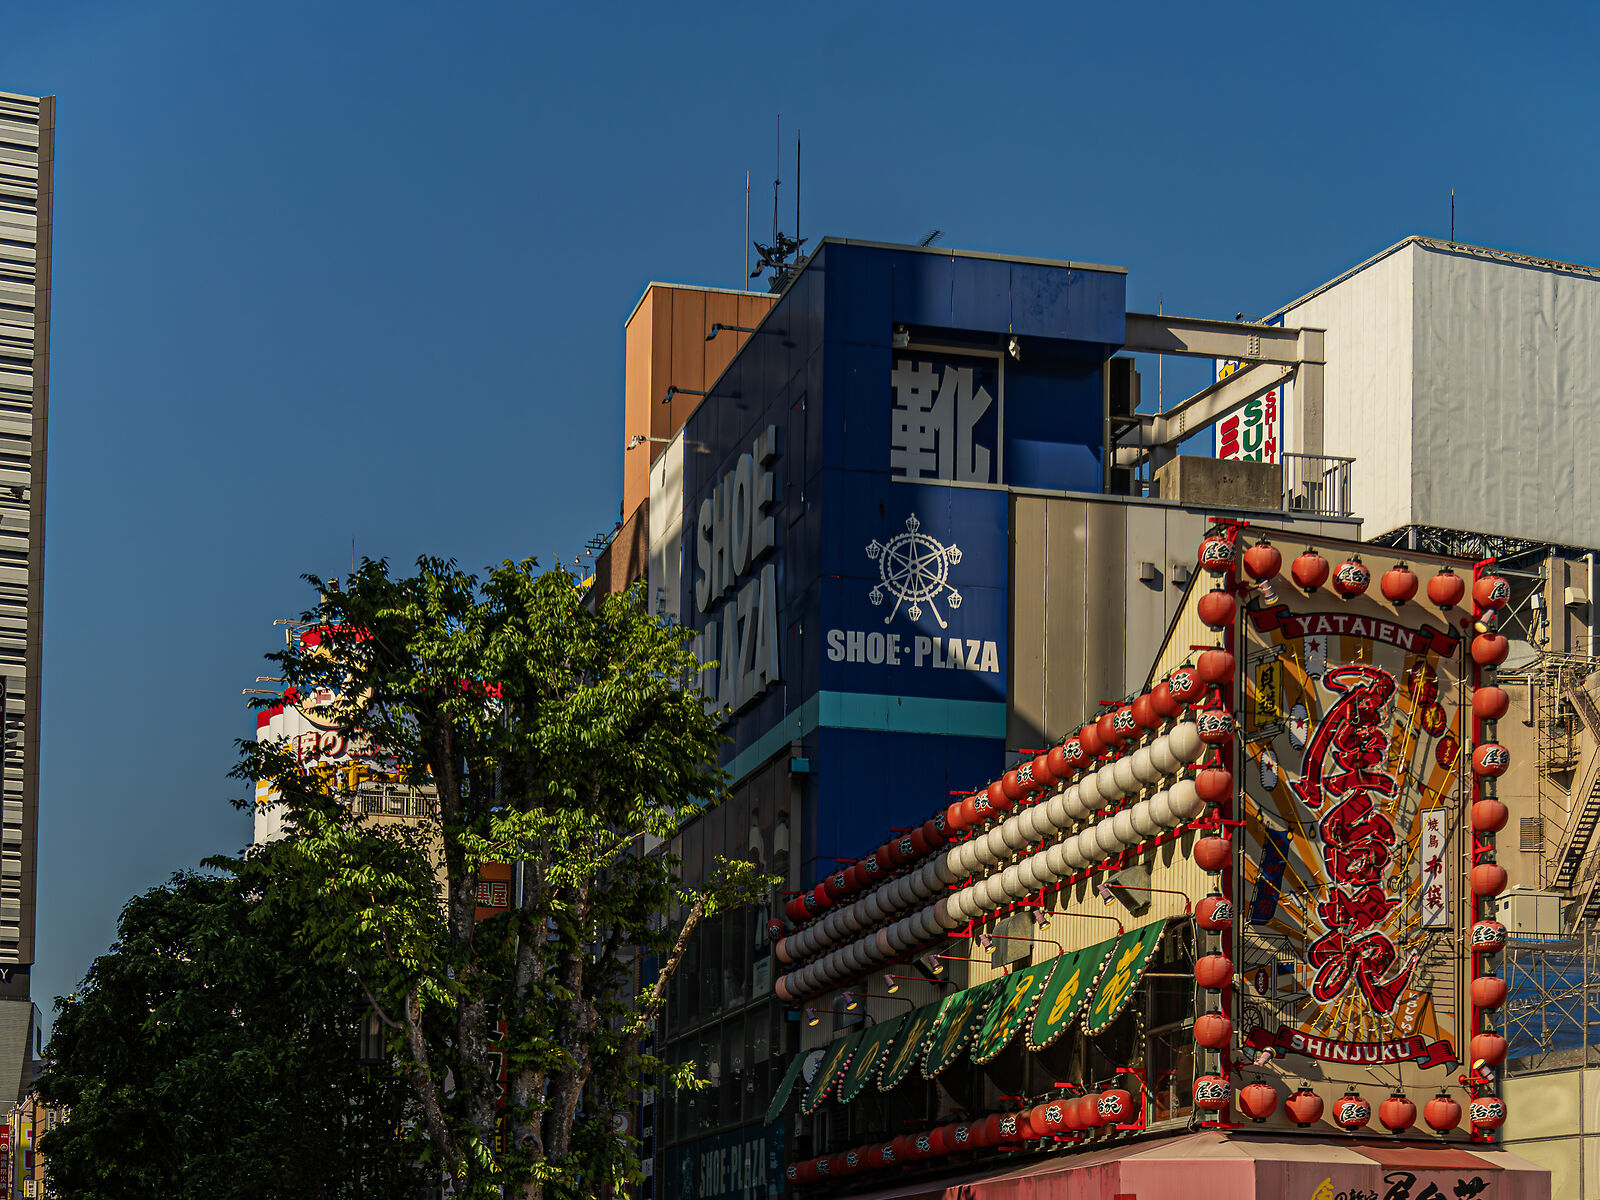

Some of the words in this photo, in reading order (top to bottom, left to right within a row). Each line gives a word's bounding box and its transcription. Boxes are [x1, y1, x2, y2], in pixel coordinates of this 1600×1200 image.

[891, 360, 992, 485] 靴
[696, 424, 777, 614] SHOE
[1296, 615, 1414, 649] YATAIEN
[1197, 714, 1233, 736] 屋台苑
[1290, 665, 1418, 1015] 屋台苑
[1424, 817, 1446, 911] 焼鳥布袋
[1290, 1034, 1411, 1061] SHINJUKU
